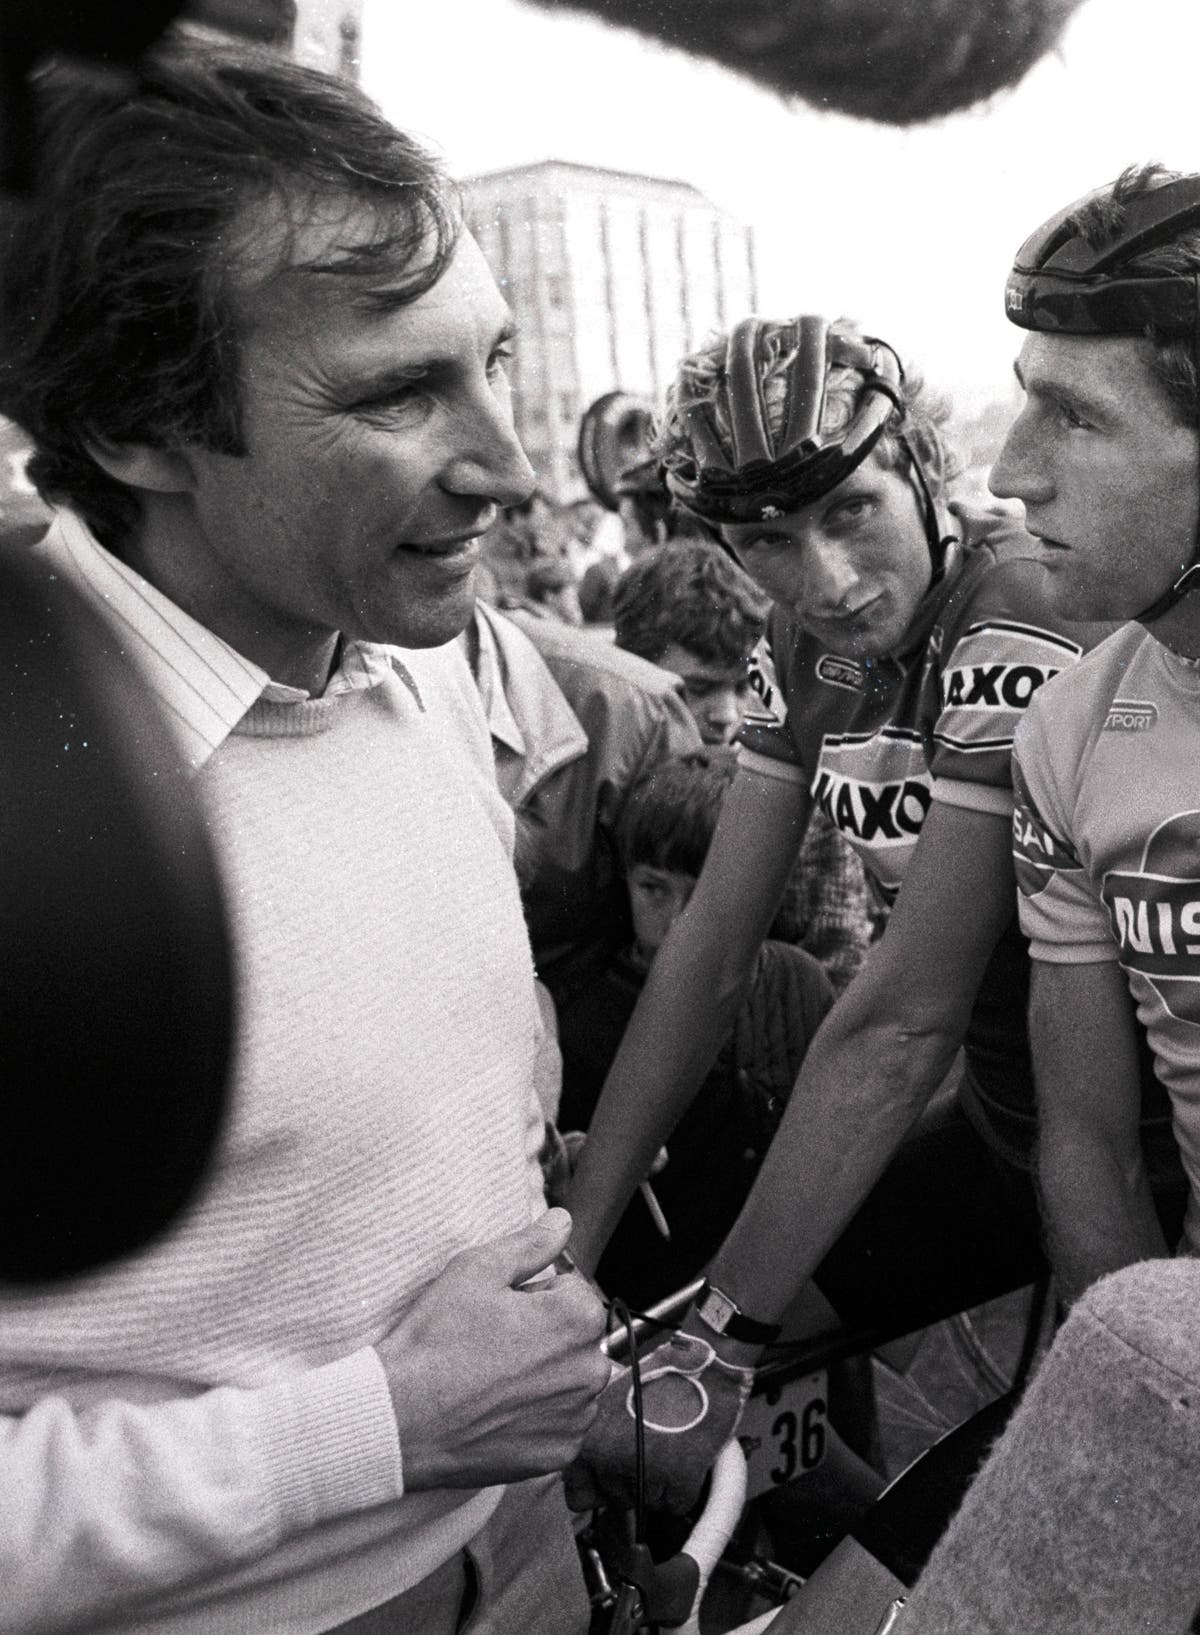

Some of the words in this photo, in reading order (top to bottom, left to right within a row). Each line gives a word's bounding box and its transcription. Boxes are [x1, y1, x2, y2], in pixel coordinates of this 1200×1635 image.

[947, 665, 1060, 709] AXO
[815, 772, 932, 841] MAXO
[771, 1398, 826, 1484] 36
